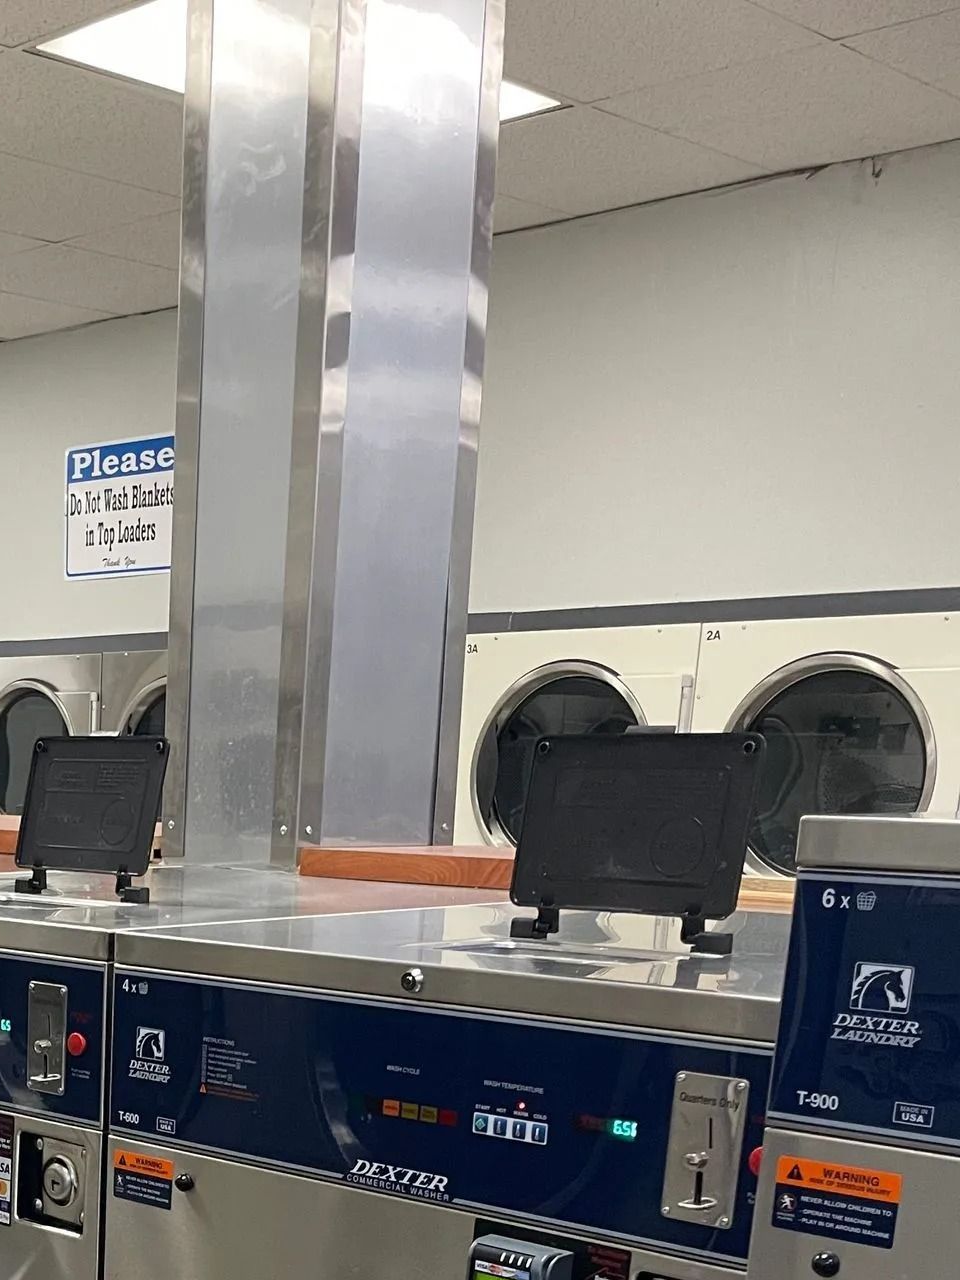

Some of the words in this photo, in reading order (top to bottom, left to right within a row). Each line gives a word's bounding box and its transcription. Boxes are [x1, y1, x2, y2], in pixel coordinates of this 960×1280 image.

[72, 447, 174, 479] Please
[70, 493, 82, 516] Do
[85, 491, 101, 514] Not
[104, 486, 128, 512] Wash
[132, 482, 174, 509] Blankets
[86, 523, 94, 546] in
[98, 522, 114, 551] Top
[118, 518, 156, 543] Loaders
[706, 630, 720, 641] 2A
[466, 644, 478, 654] 3A
[822, 888, 836, 908] 6
[840, 896, 850, 909] x
[122, 978, 130, 993] 4
[833, 1013, 920, 1035] DEXTER
[830, 1028, 922, 1048] LAUNDRY
[129, 1059, 170, 1074] DEXTER
[128, 1069, 171, 1084] LAUNDRY
[680, 1092, 716, 1106] Quarters
[720, 1097, 740, 1112] Only
[797, 1090, 839, 1111] T-900
[900, 1105, 919, 1114] MADE
[118, 1111, 140, 1124] T-600
[902, 1112, 924, 1124] USA
[350, 1159, 448, 1192] DEXTER
[824, 1168, 880, 1186] WARNING
[347, 1174, 406, 1192] COMMERCIAL
[410, 1187, 450, 1202] WASHER
[801, 1196, 822, 1204] NEVER
[824, 1200, 847, 1208] ALLOW
[848, 1204, 881, 1214] CHILDREN
[844, 1216, 872, 1226] MACHINE
[835, 1224, 862, 1234] AROUND
[862, 1228, 890, 1239] MACHINE
